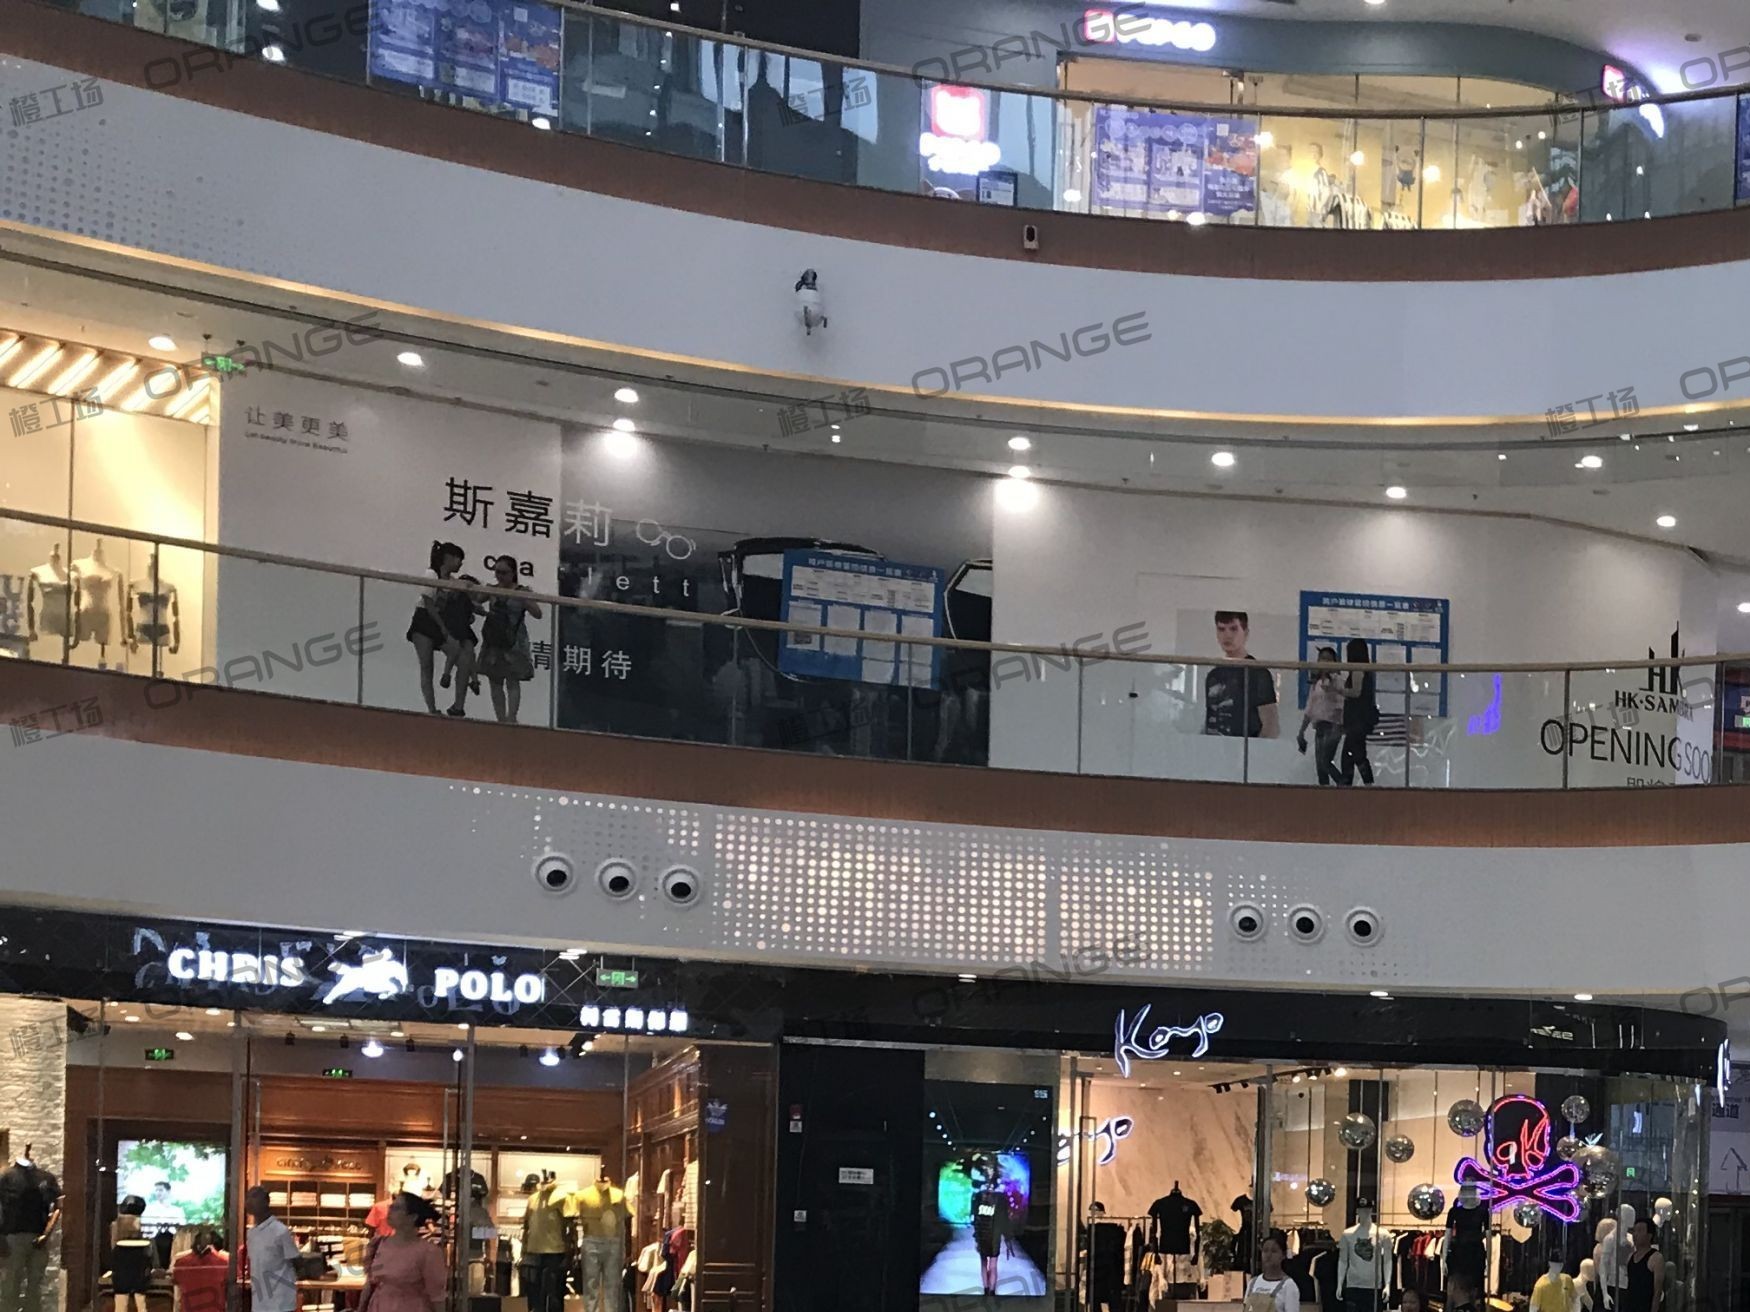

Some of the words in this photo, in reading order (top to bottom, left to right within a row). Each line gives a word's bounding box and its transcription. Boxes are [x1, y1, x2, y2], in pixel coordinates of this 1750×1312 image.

[443, 476, 613, 547] 斯嘉莉
[1541, 719, 1682, 771] OPENING
[1684, 741, 1713, 785] SOO
[167, 948, 306, 988] CHRIS
[433, 967, 547, 1004] POLO
